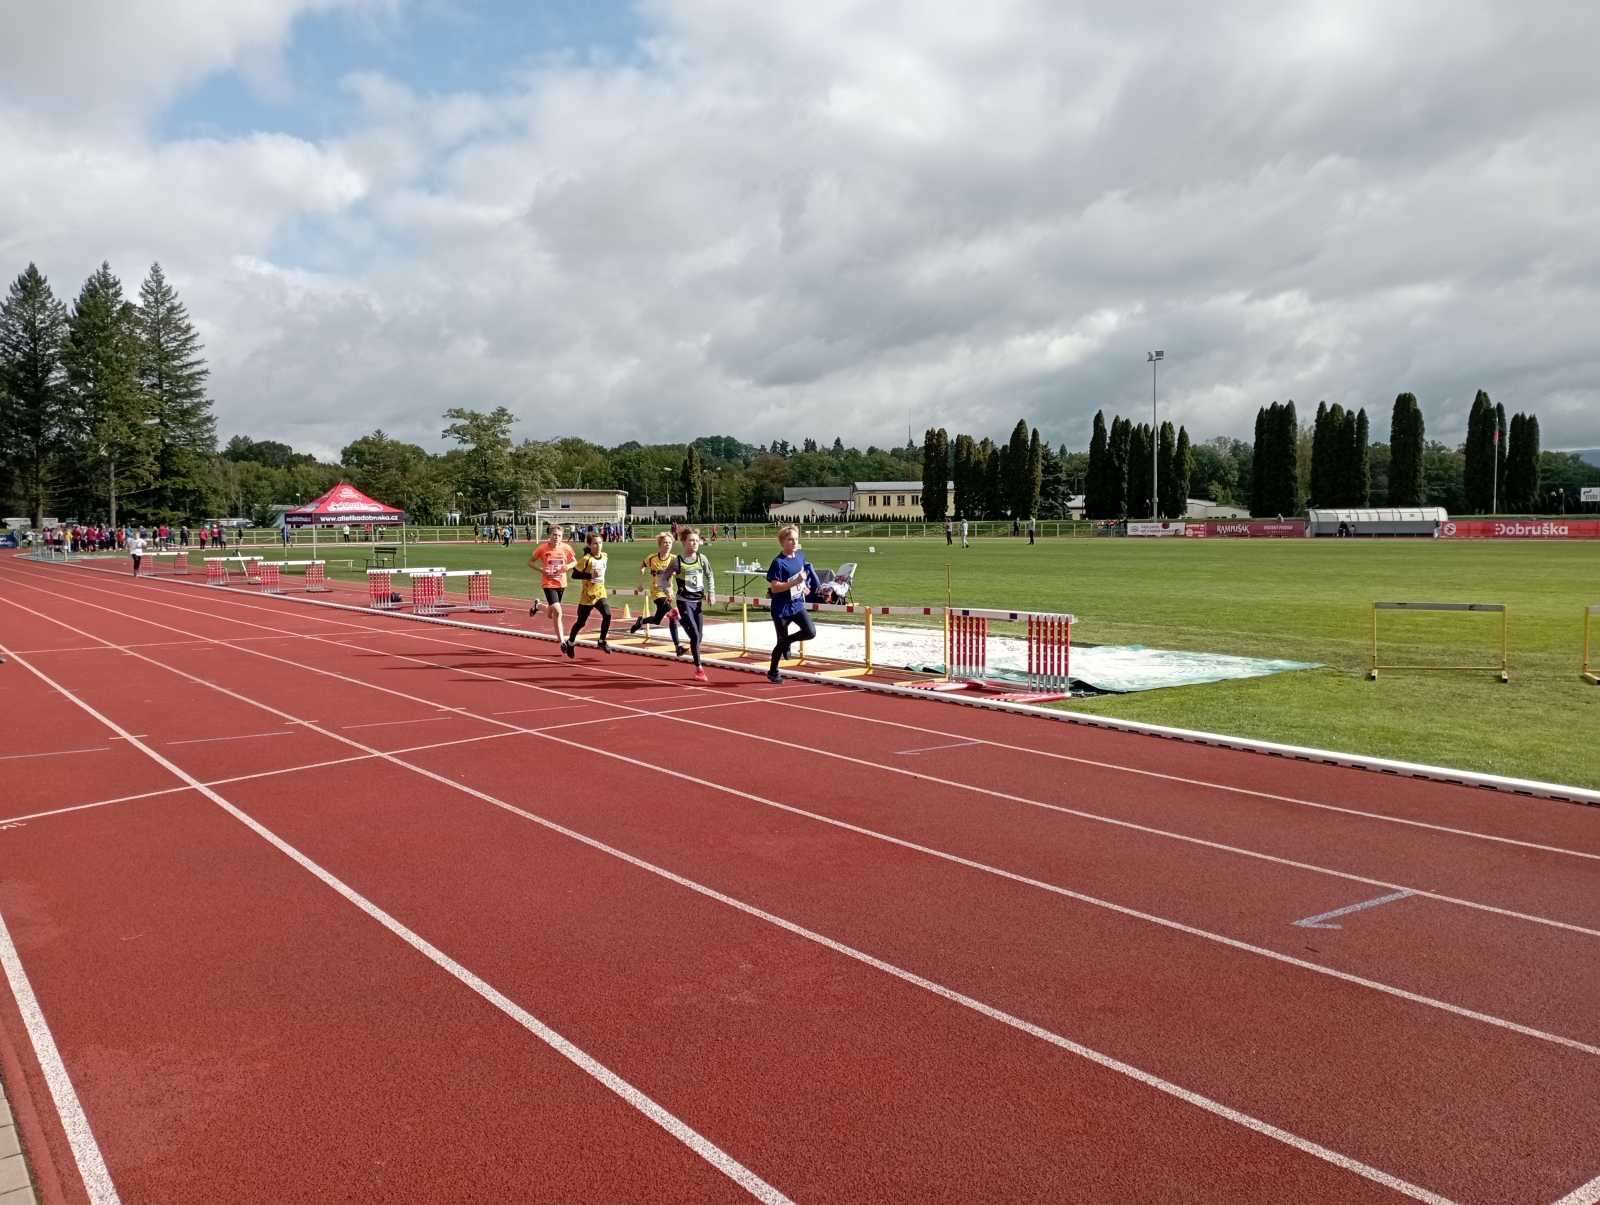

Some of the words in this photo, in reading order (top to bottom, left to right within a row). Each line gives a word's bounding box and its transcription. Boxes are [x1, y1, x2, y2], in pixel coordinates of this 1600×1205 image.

[1216, 523, 1251, 534] RAMPUŠÁK
[1495, 523, 1569, 535] Dobruška
[553, 565, 558, 574] 5
[691, 575, 698, 586] 3
